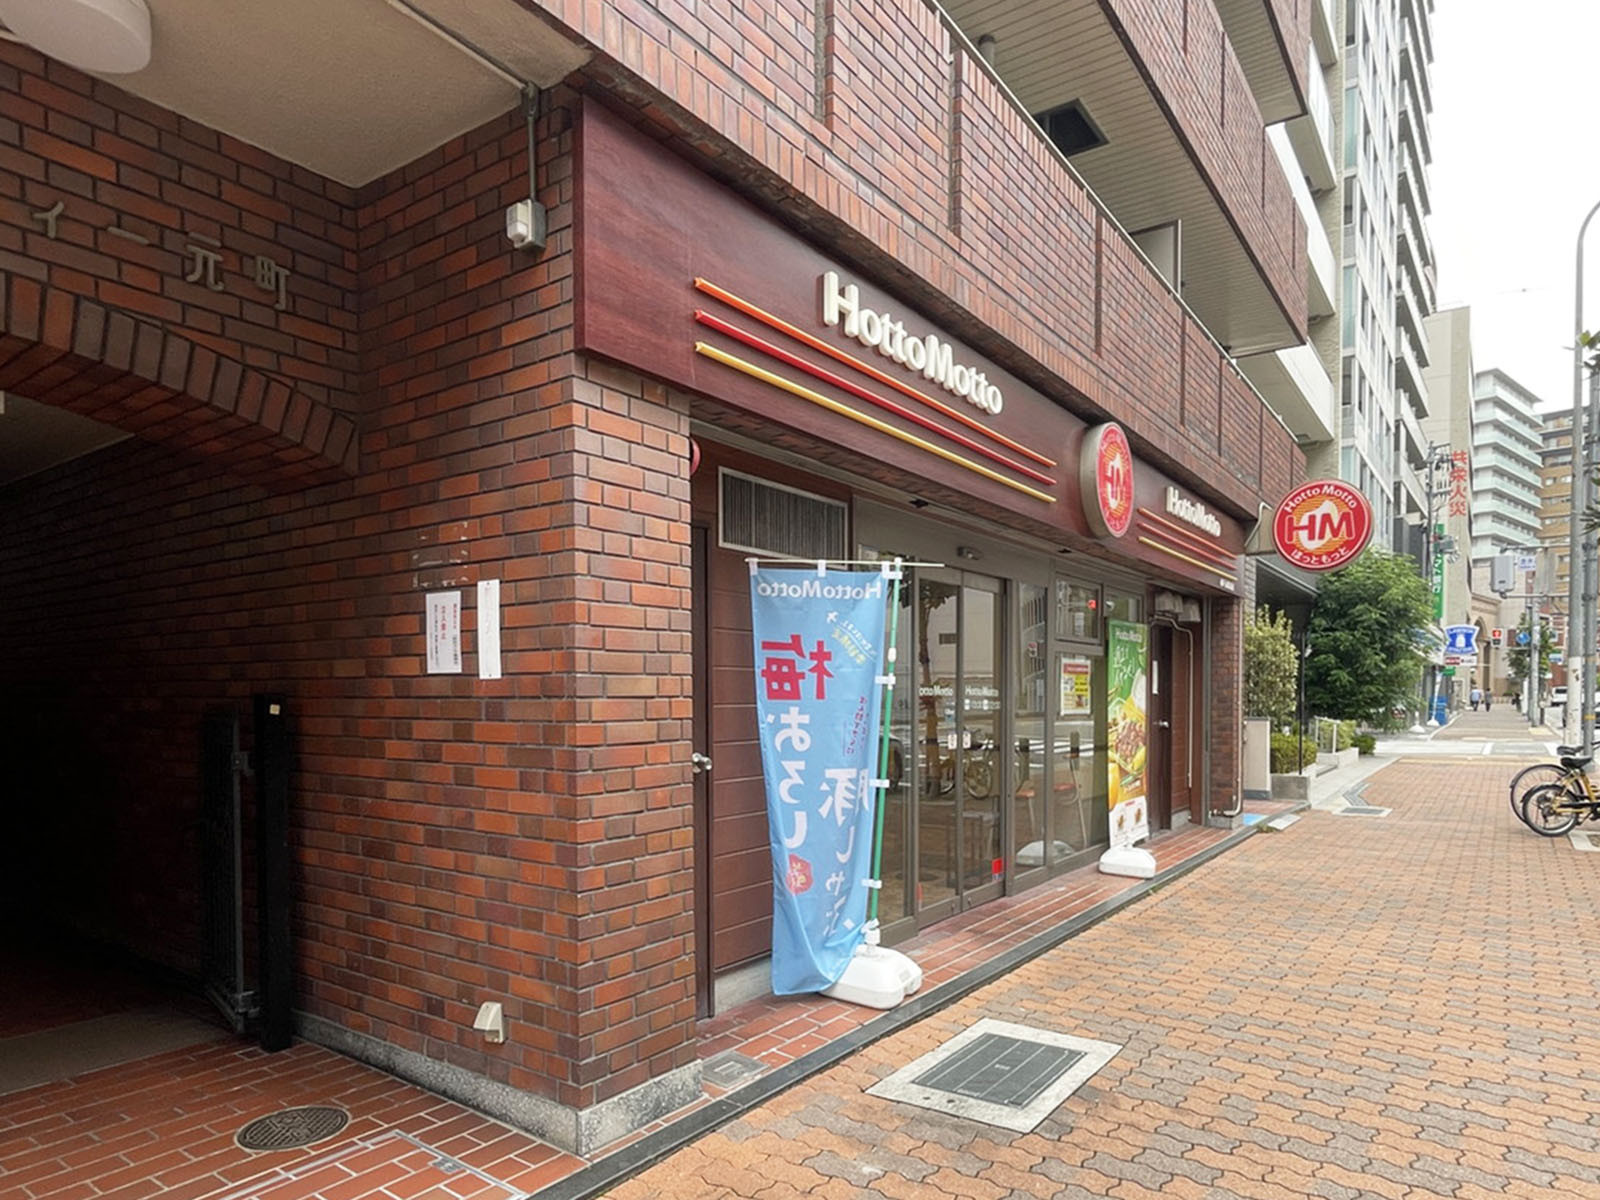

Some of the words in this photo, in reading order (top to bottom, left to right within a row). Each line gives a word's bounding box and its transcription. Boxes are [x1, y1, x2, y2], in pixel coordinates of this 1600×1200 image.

[822, 271, 1004, 415] HottoMotto
[1449, 450, 1467, 517] 共栄火災
[1166, 486, 1222, 537] HottoMotto
[1286, 511, 1355, 544] HM
[1291, 546, 1350, 566] ほっともっと
